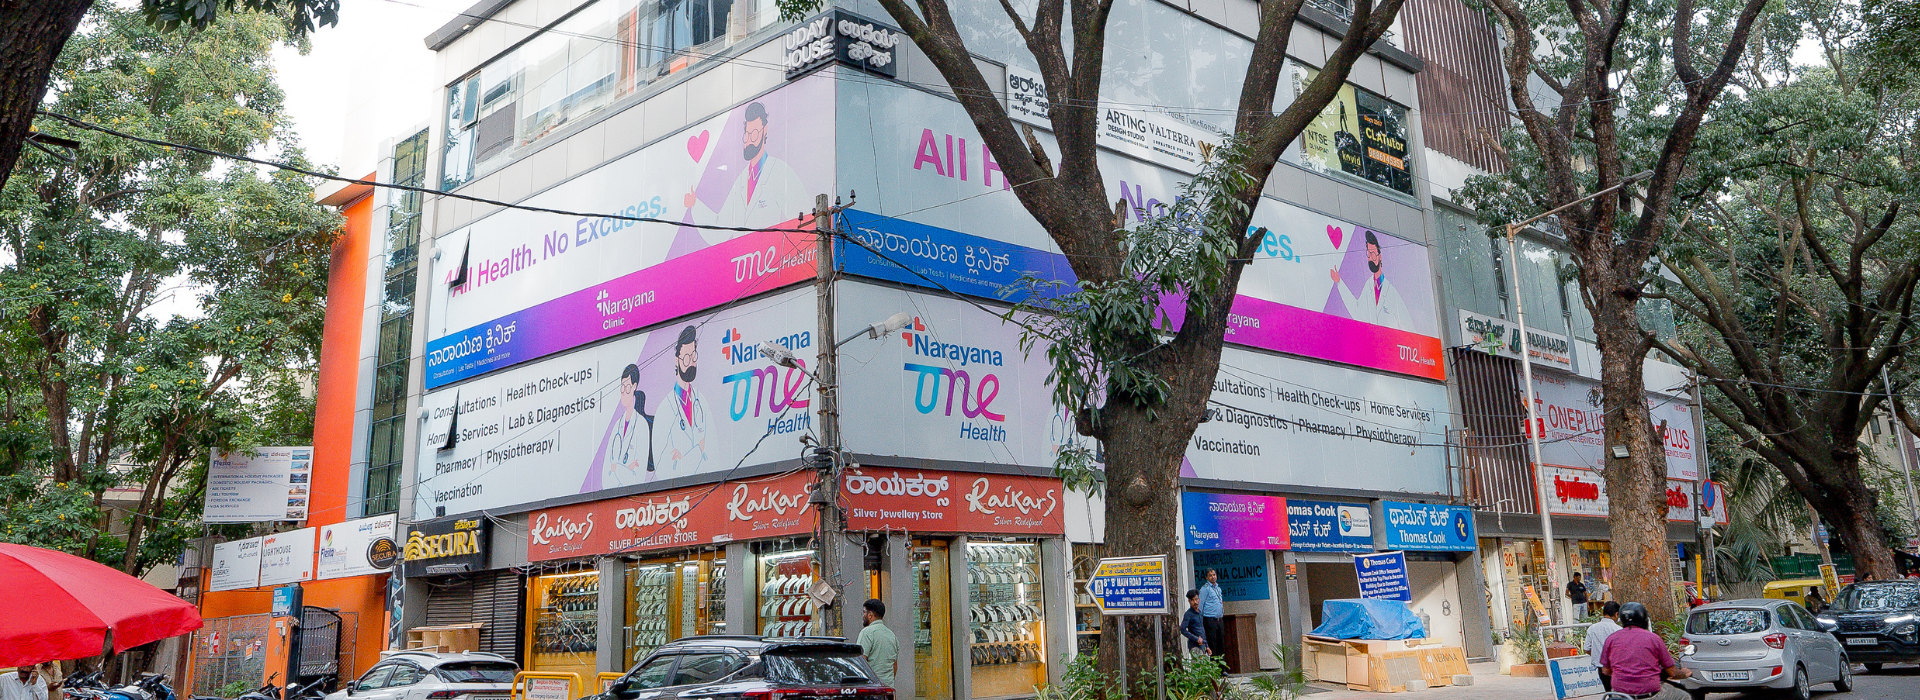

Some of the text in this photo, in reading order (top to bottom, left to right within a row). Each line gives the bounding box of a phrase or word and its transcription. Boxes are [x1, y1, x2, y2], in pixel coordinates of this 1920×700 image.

[786, 16, 832, 50] UDAY
[782, 36, 835, 70] HOUSE
[1106, 108, 1147, 133] ARTING
[1107, 124, 1145, 141] DESIGN STUDIO
[1148, 122, 1196, 148] VALTERRA
[1307, 129, 1328, 146] NTSE
[913, 128, 967, 182] All
[477, 244, 536, 287] Health.
[543, 230, 568, 260] No
[575, 195, 667, 247] Excuses.
[857, 226, 1010, 276] ನಾರಾಯಣ ಕ್ಲಿನಿಕ್
[782, 248, 819, 270] Health
[949, 272, 977, 285] Medicines
[602, 289, 655, 317] Narayana
[602, 317, 625, 331] Clinic
[1227, 312, 1260, 329] rayana
[429, 320, 517, 367] ನಾರಾಯಣ ಕ್ಲಿನಿಕ್
[914, 333, 1003, 367] Narayana
[506, 381, 537, 402] Health
[539, 367, 593, 392] Check-ups
[1212, 378, 1431, 422] sultations Health Check-ups Home Services
[462, 423, 499, 442] Services
[508, 415, 526, 430] Lab
[527, 411, 534, 424] &
[536, 396, 596, 423] Diagnostics
[767, 412, 811, 435] Health
[1215, 407, 1417, 448] & Diagnostics Pharmacy Physiotherapy
[1549, 404, 1604, 435] ONEPLUS
[959, 421, 1007, 443] Health
[1193, 434, 1261, 456] Vaccination
[436, 438, 554, 475] Pharmacy Physiotherapy
[434, 483, 482, 503] Vaccination
[853, 508, 943, 520] Silver Jewellery Store
[1314, 504, 1337, 517] Cook
[1429, 506, 1450, 527] ಕುಕ್
[751, 520, 770, 531] Silver
[993, 516, 1043, 529] Silver Redefined
[421, 530, 480, 560] SECURA
[609, 538, 632, 550] SILVER
[634, 533, 673, 548] JEWELLERY
[673, 531, 698, 543] STORE
[1193, 531, 1219, 540] Narayana
[1399, 529, 1447, 543] Thomas Cook
[263, 545, 291, 557] LIGHTHOUSE
[371, 550, 397, 562] SECURA
[1504, 553, 1514, 567] 30
[1570, 553, 1579, 567] 30
[1116, 577, 1142, 587] MAIN ROAD
[1231, 565, 1262, 580] CLINIC
